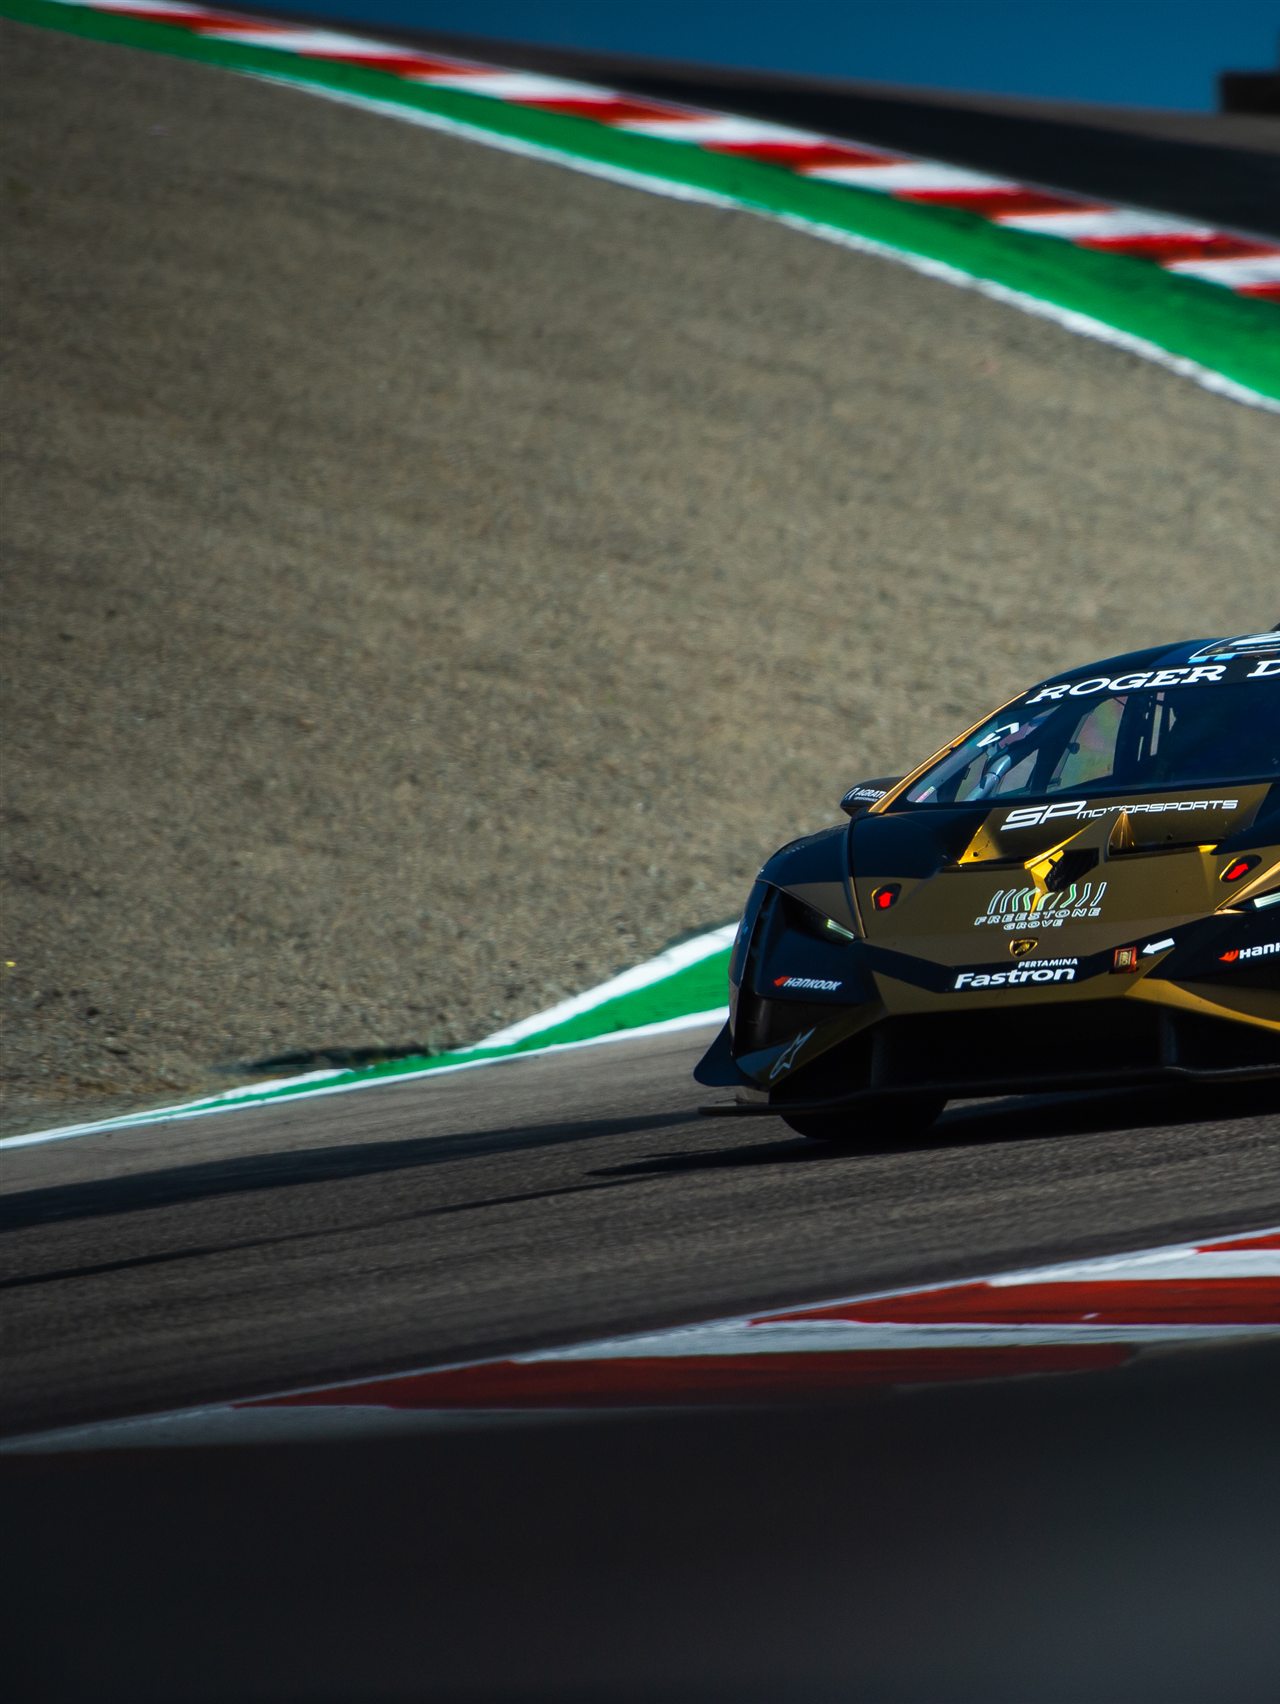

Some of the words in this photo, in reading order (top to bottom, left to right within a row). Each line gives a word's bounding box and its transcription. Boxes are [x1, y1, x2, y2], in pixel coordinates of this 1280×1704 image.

[1025, 665, 1227, 704] ROGER
[1000, 800, 1087, 831] SP
[974, 907, 1101, 926] FREESTONE
[1003, 918, 1064, 930] GROVE
[1018, 958, 1078, 969] PERTAMINA
[954, 967, 1076, 989] Fastron
